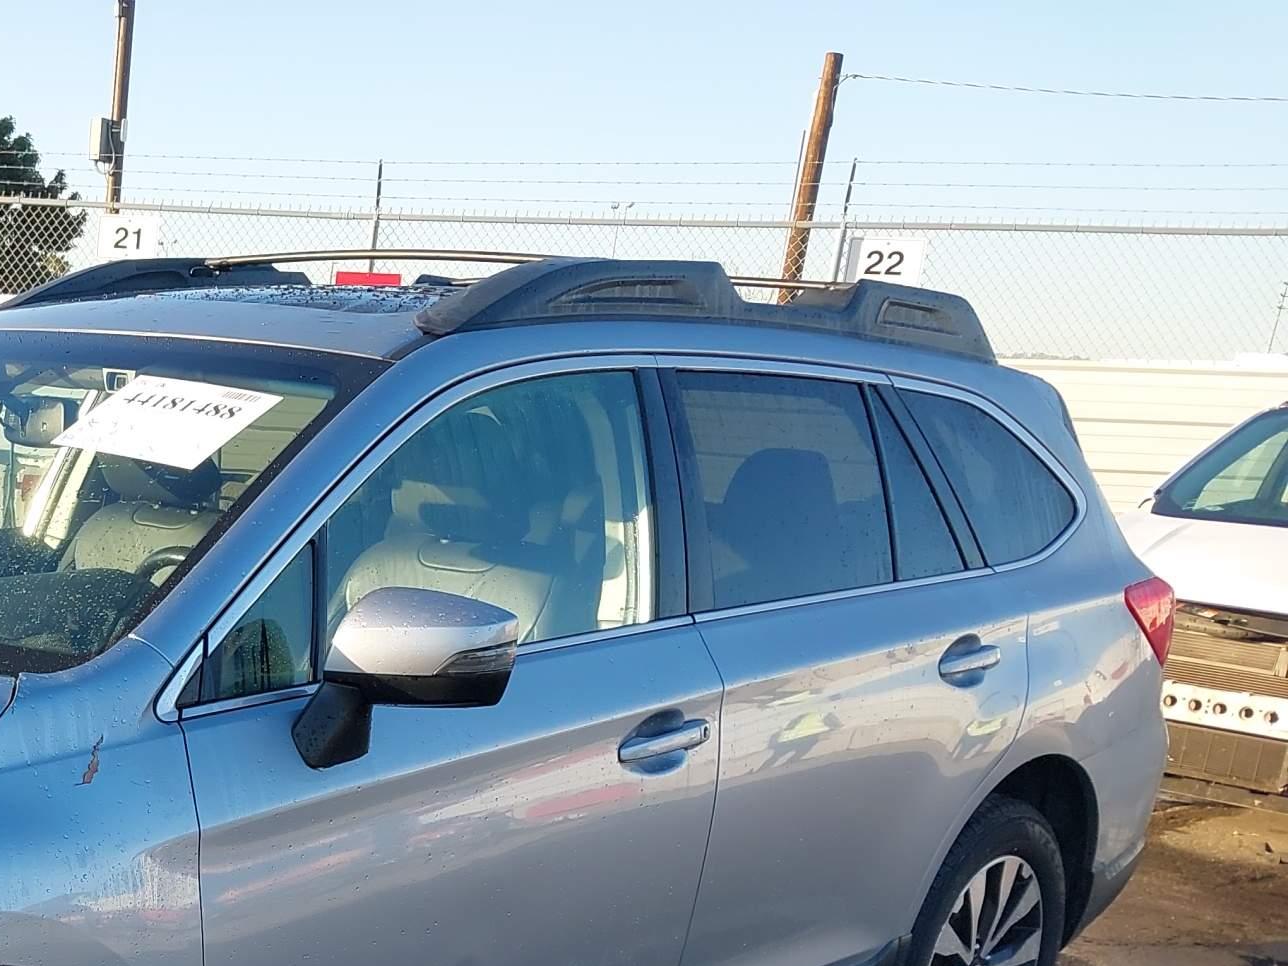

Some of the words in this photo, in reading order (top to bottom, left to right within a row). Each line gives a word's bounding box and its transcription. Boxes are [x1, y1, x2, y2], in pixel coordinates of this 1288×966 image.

[113, 226, 142, 250] 21
[863, 249, 905, 276] 22
[123, 392, 242, 419] 44181488
